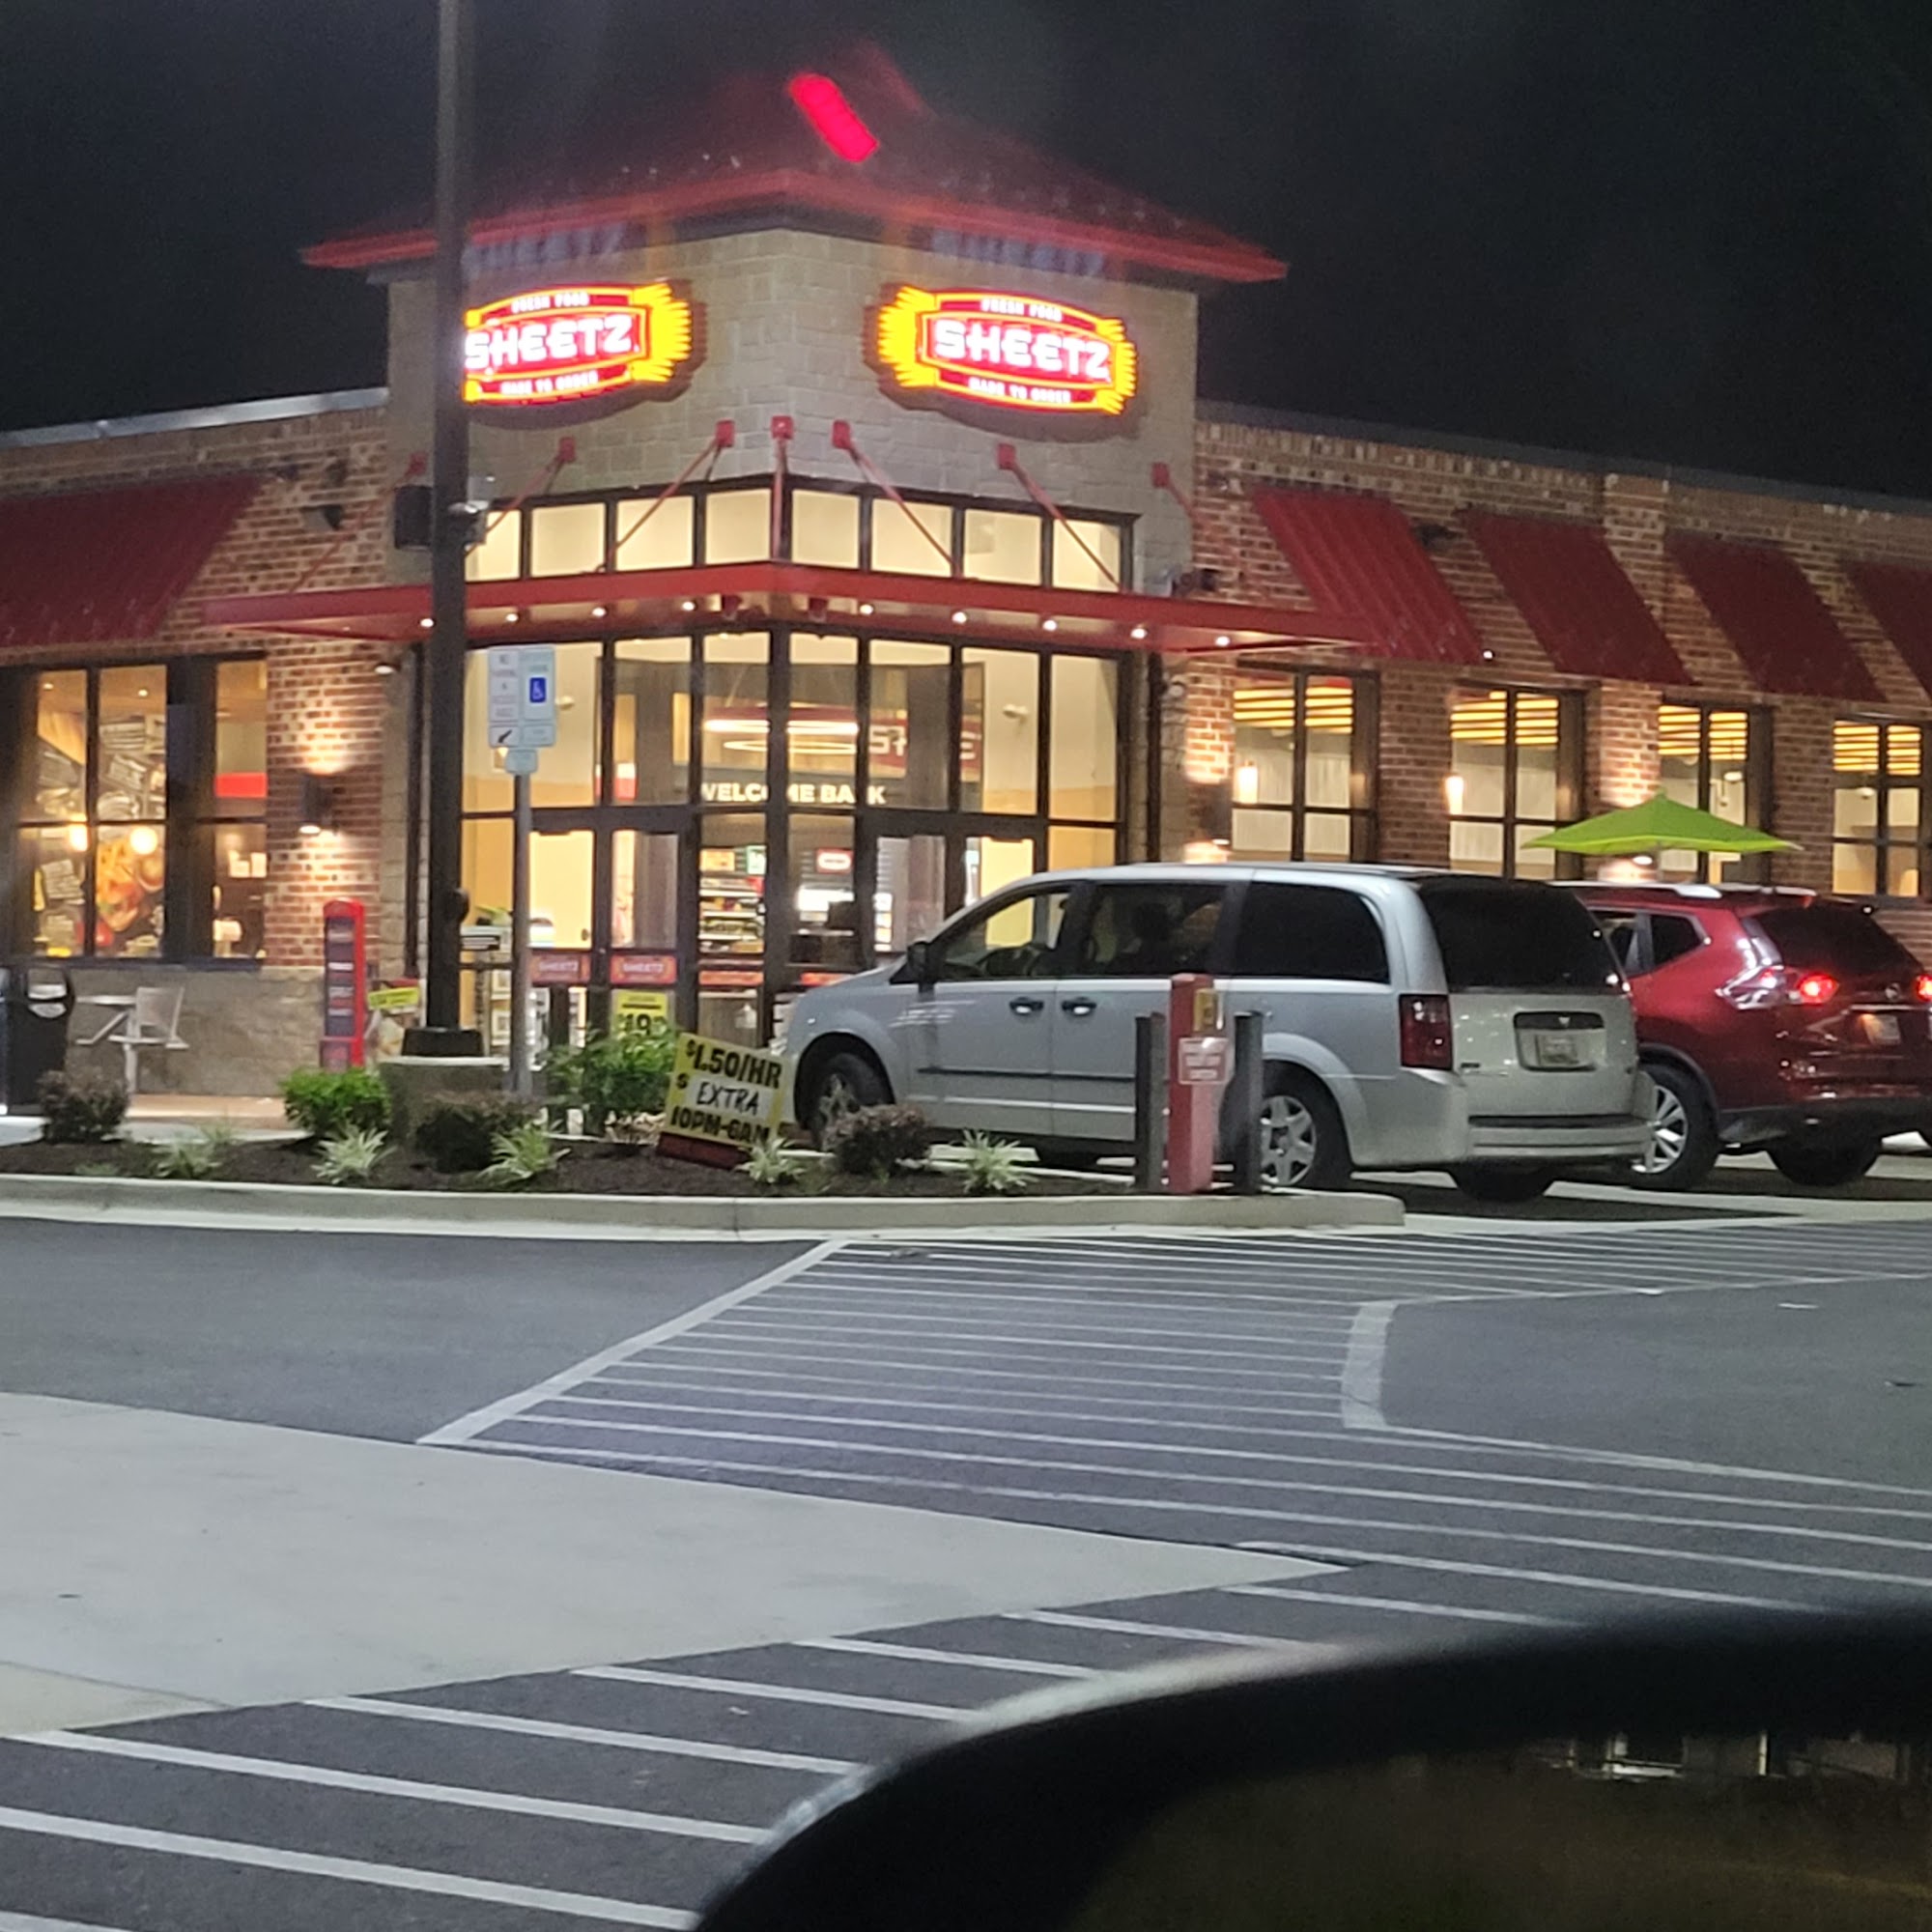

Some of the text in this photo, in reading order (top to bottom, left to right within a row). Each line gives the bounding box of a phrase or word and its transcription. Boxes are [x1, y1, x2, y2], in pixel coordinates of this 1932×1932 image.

[465, 314, 633, 369] SHEETZ
[934, 319, 1111, 381] SHEETZ
[820, 784, 887, 805] BAK
[696, 1081, 759, 1116] EXTRA
